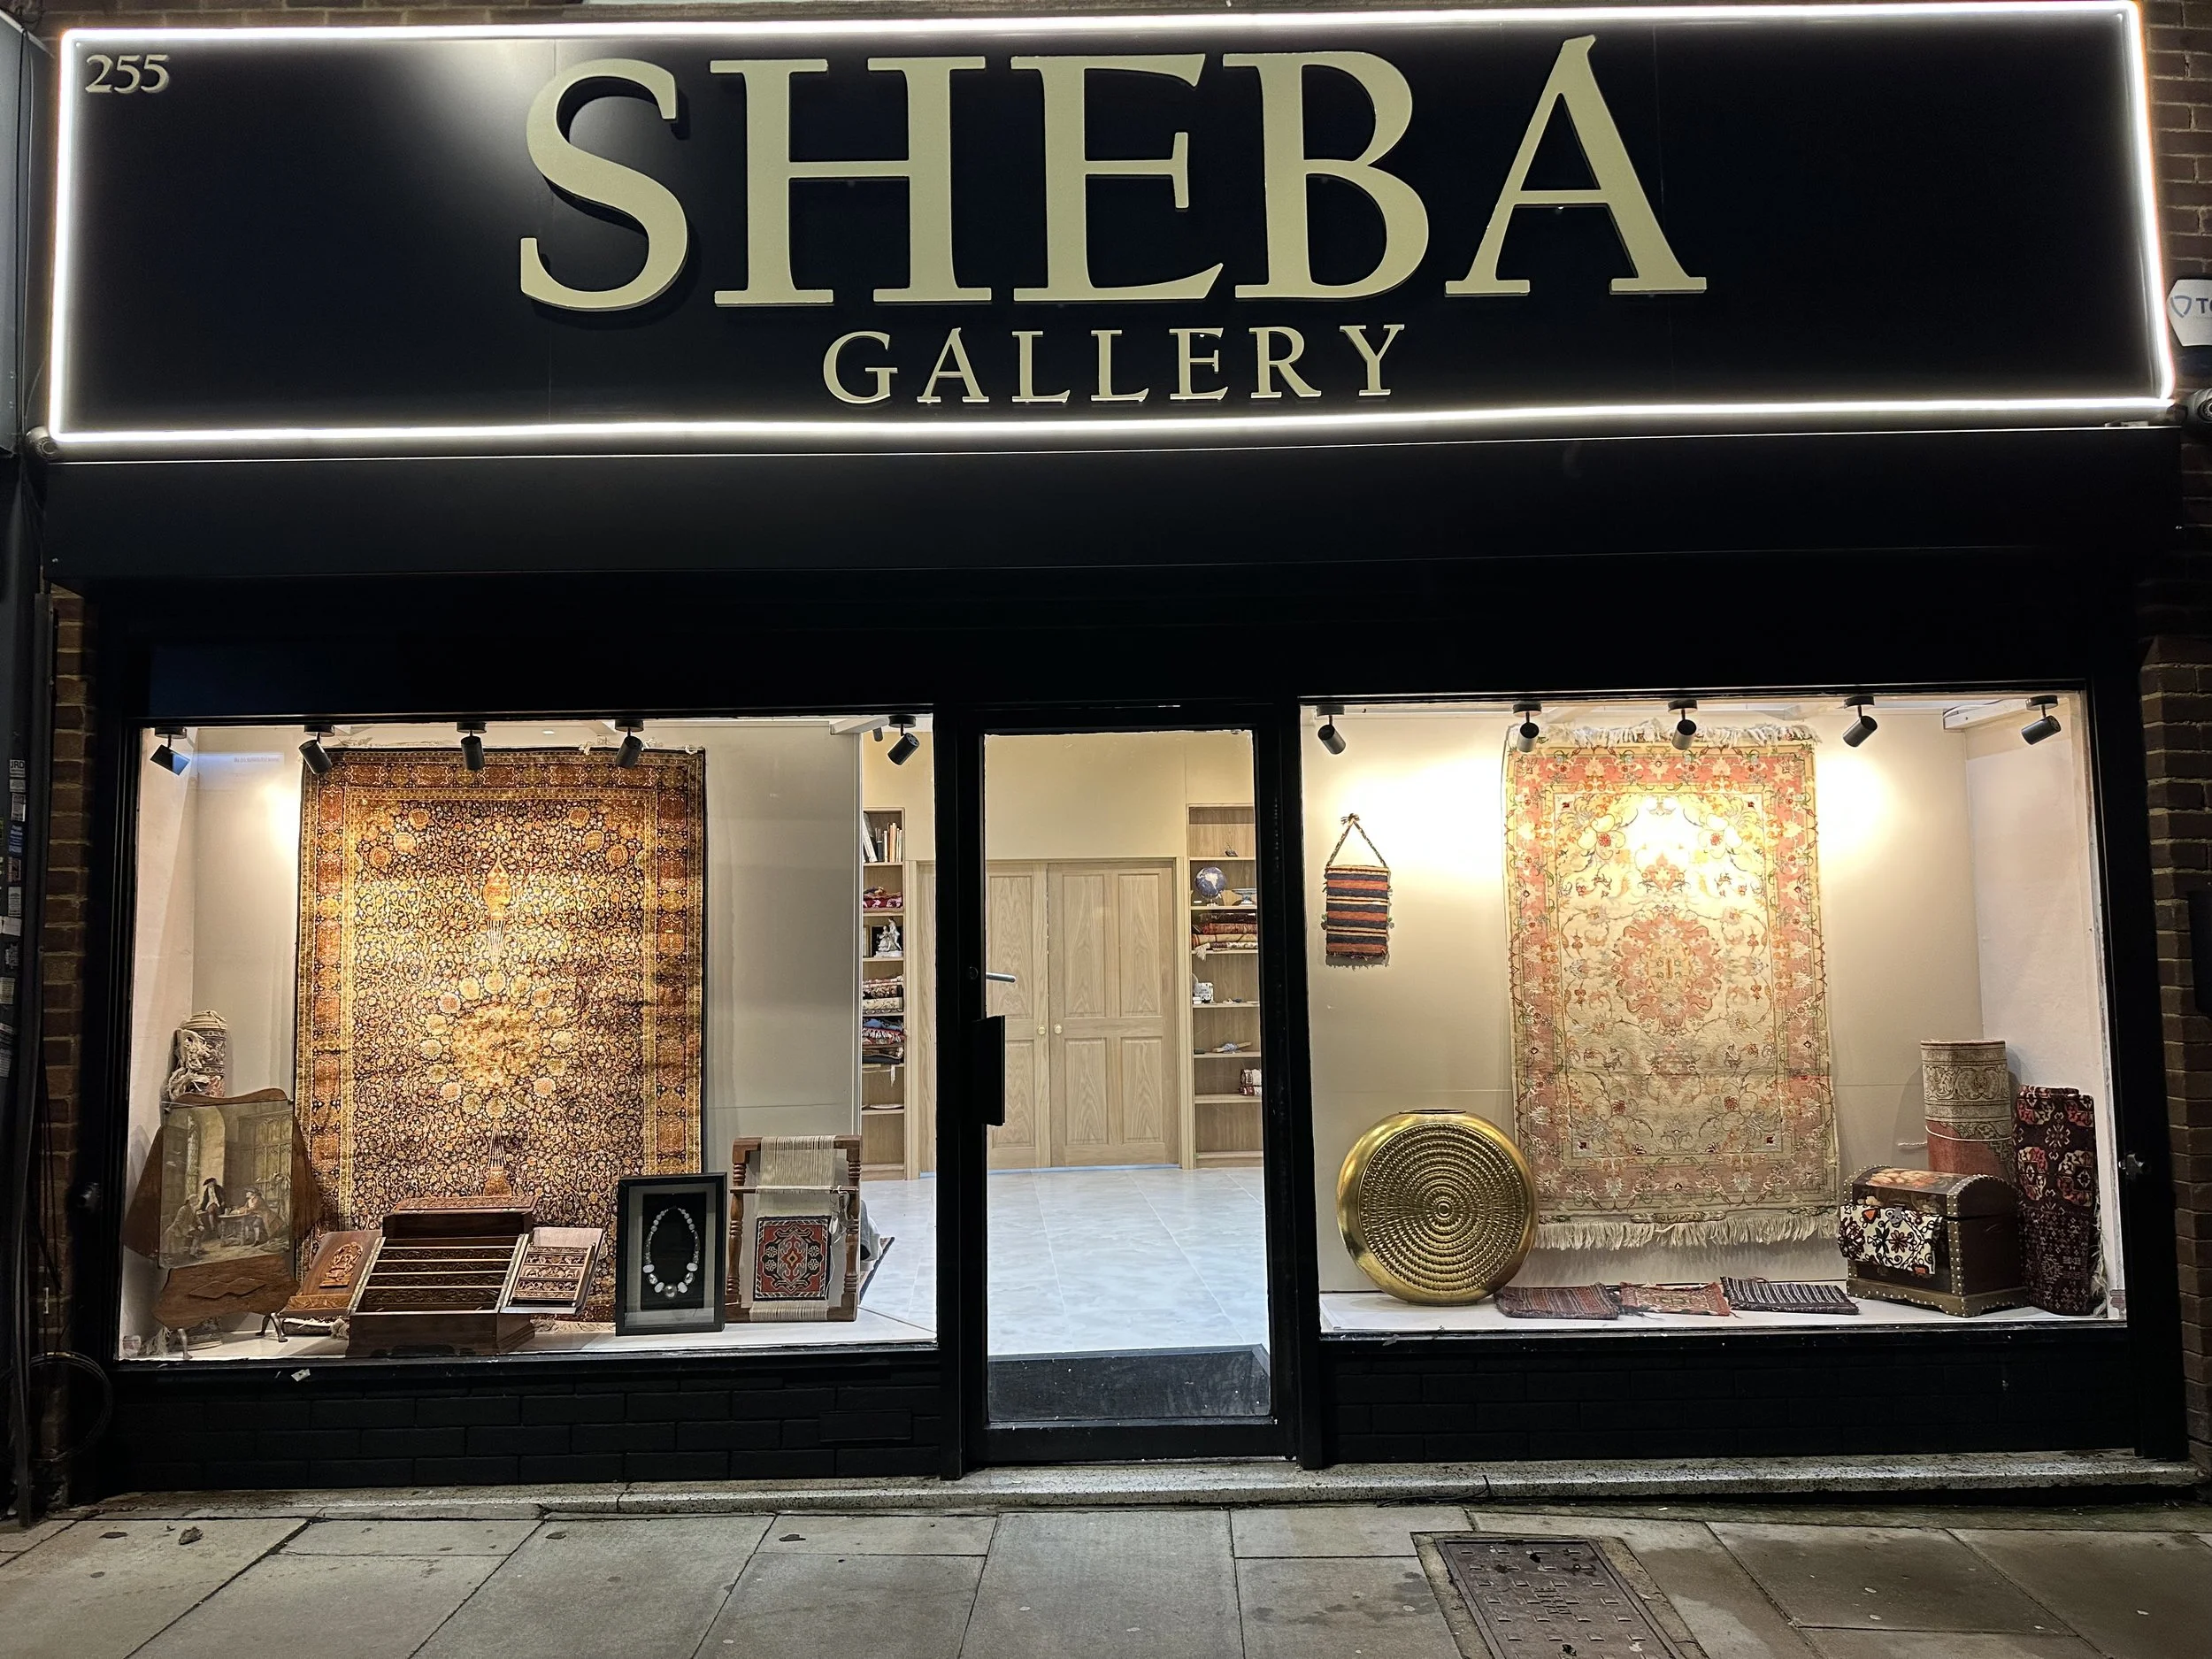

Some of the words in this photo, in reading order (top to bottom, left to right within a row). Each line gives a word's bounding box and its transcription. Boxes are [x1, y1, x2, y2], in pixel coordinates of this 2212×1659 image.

[85, 54, 169, 94] 255
[520, 35, 1708, 311] SHEBA
[2195, 297, 2212, 314] T
[823, 324, 1405, 406] GALLERY
